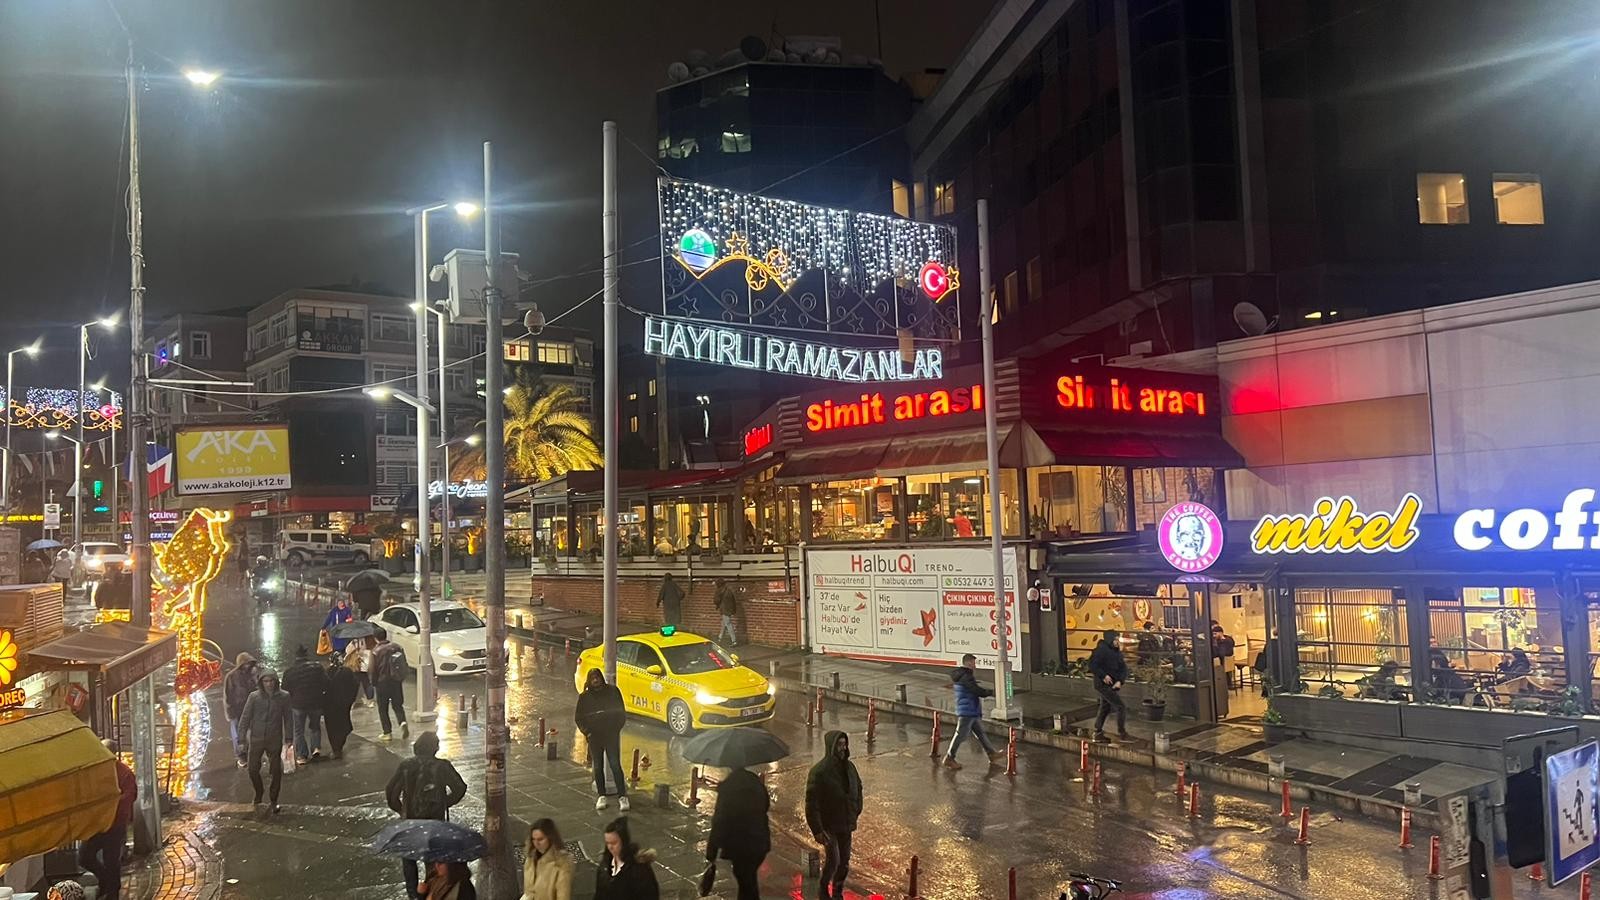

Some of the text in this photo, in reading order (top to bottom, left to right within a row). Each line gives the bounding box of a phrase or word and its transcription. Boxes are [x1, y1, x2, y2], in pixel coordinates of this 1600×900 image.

[326, 343, 353, 352] GROUP
[644, 317, 943, 381] HAYIRLI RAMAZANLAR
[1056, 375, 1133, 411] Siit
[806, 385, 984, 432] Simit arası
[184, 478, 285, 490] www.akakoleji.k12.tr
[428, 480, 458, 499] Glria
[372, 496, 400, 506] ECZ
[1165, 504, 1214, 523] THE COFFEE
[1252, 493, 1422, 553] mikel
[851, 553, 917, 574] HalbuQi
[1168, 551, 1214, 569] COMPANY
[824, 576, 865, 586] halbuqitrend
[881, 577, 924, 586] halbuqi.com
[953, 577, 971, 586] 0532
[973, 577, 987, 587] 449
[879, 594, 891, 603] Hiç
[946, 594, 966, 604] ÇIKIN
[966, 595, 987, 605] ÇIKIN
[820, 603, 850, 612] Tarz Var
[879, 605, 903, 614] bizden
[880, 617, 908, 626] giydiniz
[821, 625, 858, 635] Hayat Var
[880, 628, 894, 636] mi?
[630, 694, 648, 708] TAH
